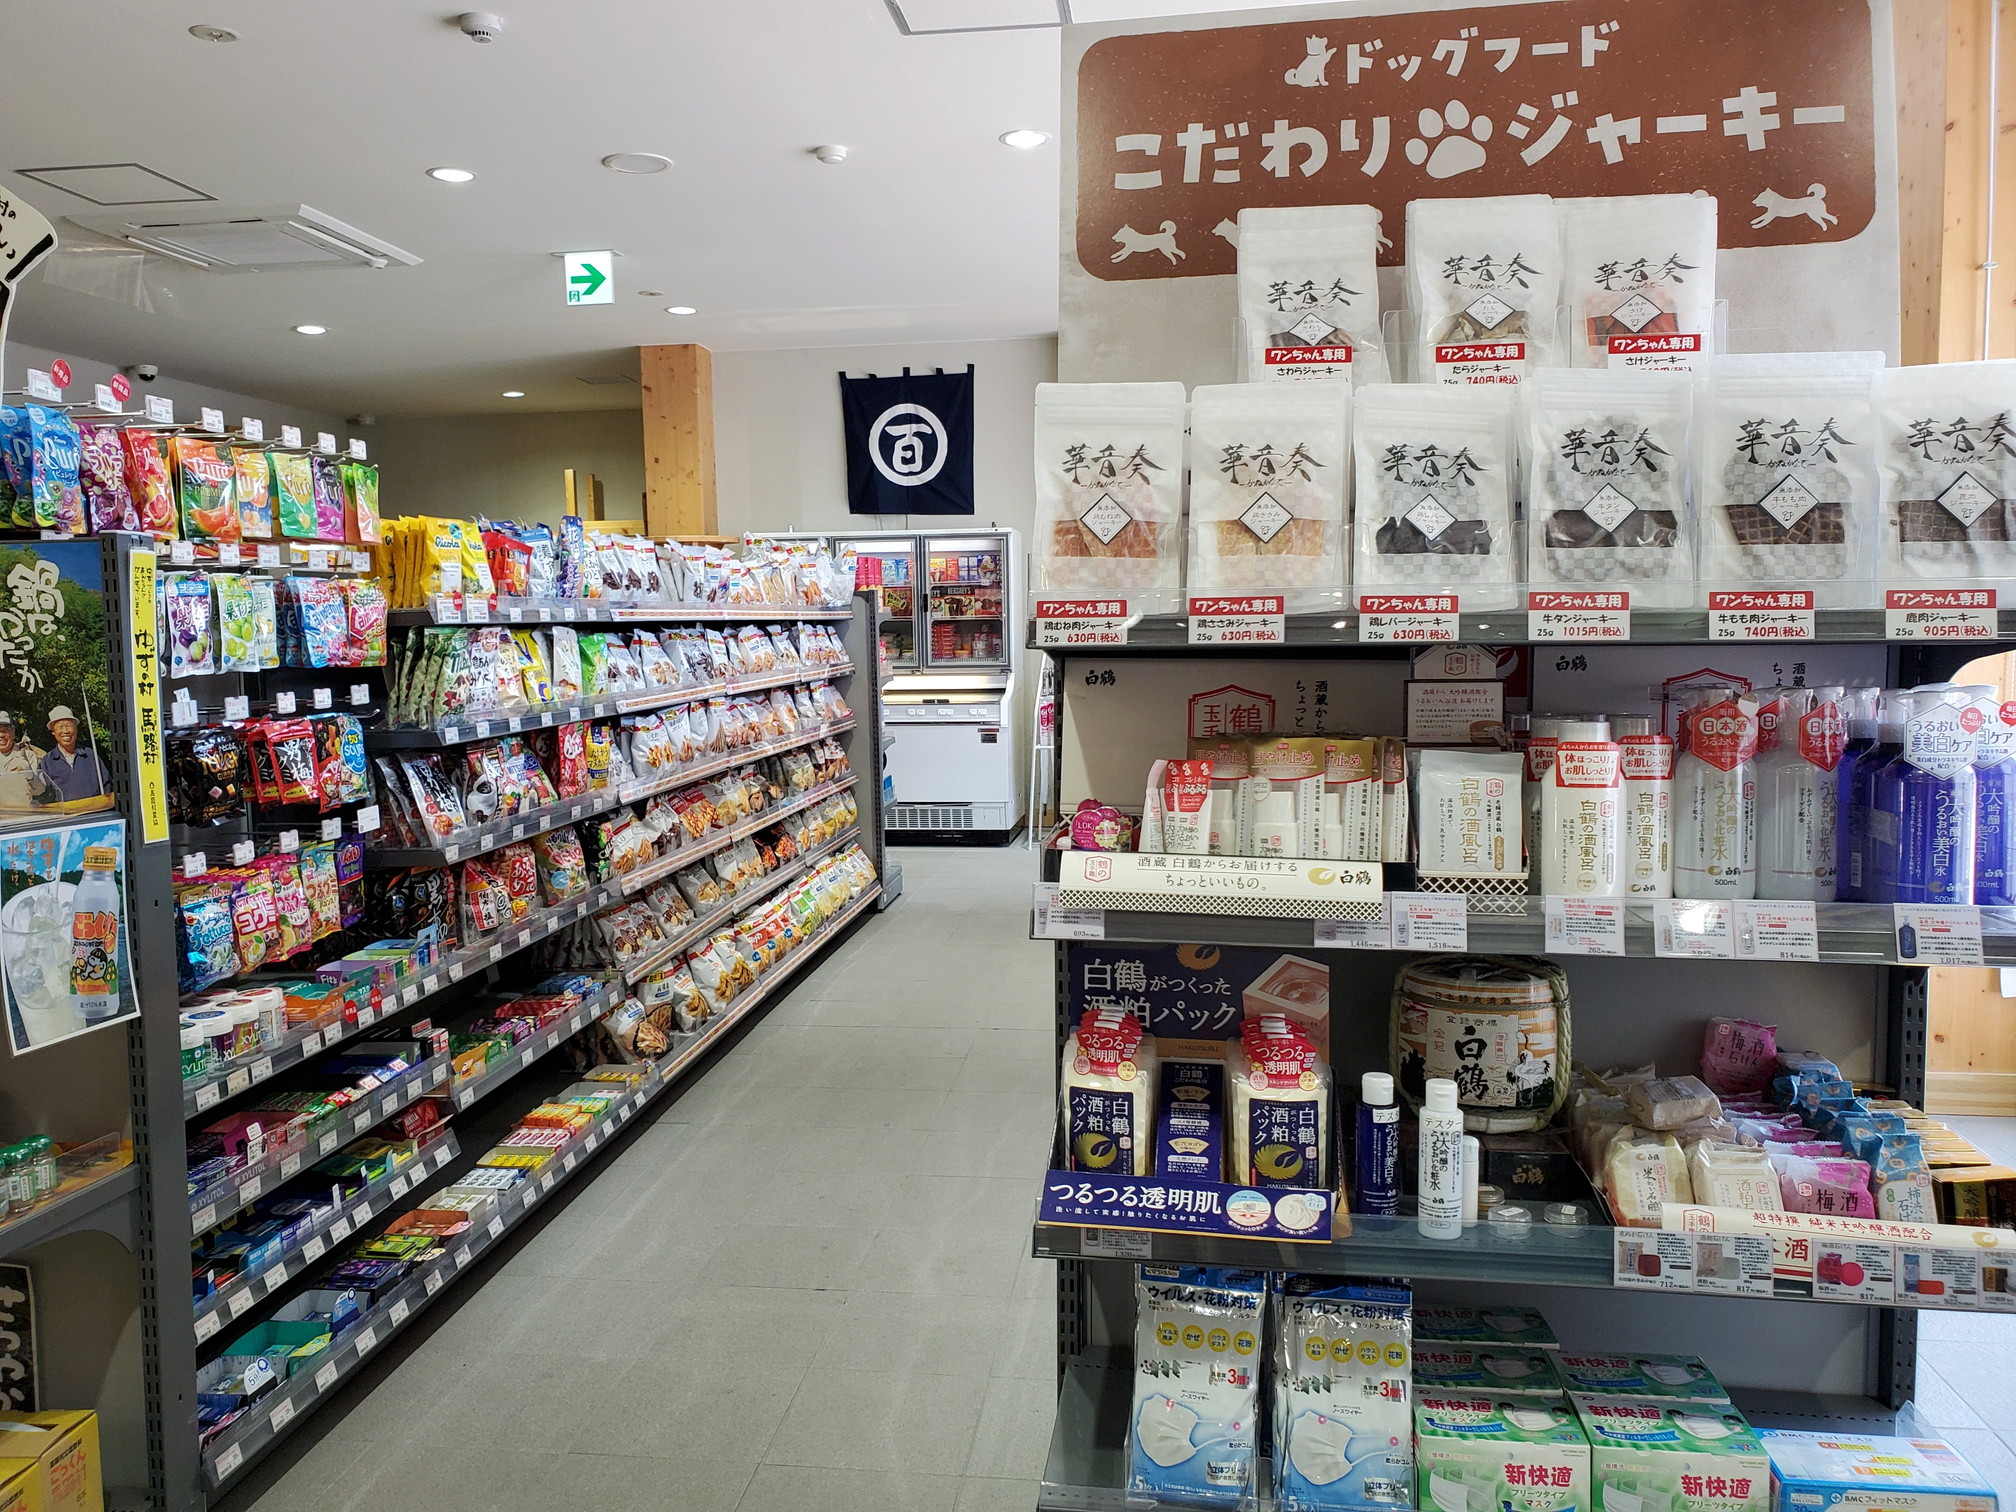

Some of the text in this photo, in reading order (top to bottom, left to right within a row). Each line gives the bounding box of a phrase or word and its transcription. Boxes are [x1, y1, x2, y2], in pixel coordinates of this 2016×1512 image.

[1345, 20, 1621, 84] ドッグフード
[1113, 86, 1845, 191] こだわり ジャーキー
[1442, 253, 1544, 289] 華音奏
[1594, 253, 1700, 291] 華音奏
[1267, 278, 1364, 312] 華音奏
[1614, 336, 1694, 350] ワンちゃん専用
[1270, 348, 1346, 362] ワンちゃん専用
[1441, 347, 1518, 360] ワンちゃん専用
[1626, 356, 1686, 365] さけジャーキー
[1277, 366, 1342, 376] さわらジャーキー
[1452, 364, 1510, 374] たらジャーキー
[884, 424, 932, 473] 百
[1736, 417, 1857, 463] 華音奏
[1561, 428, 1673, 472] 華音奏
[1062, 443, 1167, 486] 華音奏
[1219, 442, 1326, 485] 華音奏
[1382, 444, 1490, 486] 華音奏
[1195, 600, 1278, 612] ワンちゃん専用
[1366, 597, 1451, 611] ワンちゃん専用
[1535, 594, 1622, 608] ワンちゃん専用
[1716, 593, 1806, 607] ワンちゃん専用
[1894, 592, 1989, 606] ワンちゃん専用
[1042, 602, 1121, 615] ワンちゃん専用
[1906, 612, 1980, 622] 鹿肉ジャーキー
[1044, 621, 1121, 631] 鶏むね肉ジャーキー
[1197, 619, 1278, 629] 鶏ささみジャーキー
[1369, 616, 1452, 627] 鶏レバージャーキー
[1543, 613, 1618, 623] 牛タンジャーキー
[1718, 613, 1808, 624] 牛もも肉ジャーキー
[1067, 633, 1124, 643] 630円(税込)
[1197, 631, 1280, 641] 25g 630円(税込)
[1368, 628, 1454, 640] 25g 630円(税込)
[1537, 625, 1625, 637] 25g 1015円(税込)
[1718, 626, 1809, 638] 25g 740円(税込)
[1896, 626, 1993, 637] 25g 905円(税込)
[134, 629, 155, 696] ゆずの村
[1556, 655, 1588, 672] 白鶴
[1085, 669, 1116, 686] 白鶴
[1792, 662, 1806, 687] 酒蔵
[1294, 680, 1307, 728] ちょっと
[1314, 680, 1328, 732] 酒蔵から
[1702, 719, 1749, 733] 日本酒
[1912, 720, 1960, 733] うるおい
[140, 708, 157, 765] 馬路村
[1911, 732, 1972, 753] 美白ケア
[1254, 750, 1315, 765] 日やけ止め
[1565, 753, 1610, 764] 体ほっこり!
[1625, 746, 1667, 757] 体ほっこり!
[1565, 765, 1614, 775] お肌しっとり!
[1625, 757, 1670, 768] お肌しっとり!
[1986, 788, 2004, 834] 大吟醸の
[1459, 777, 1482, 864] 白鶴の酒風呂
[1636, 792, 1655, 860] 白鶴の酒風呂
[1711, 781, 1728, 862] うるおい化粧水
[1948, 801, 1964, 846] 大吟醸の
[1578, 800, 1598, 871] 白鶴の酒風呂
[1932, 789, 1950, 877] うるおい美白水
[1137, 856, 1299, 873] 酒蔵 白鶴からお届けする
[1985, 868, 2004, 878] 白鶴
[1165, 875, 1267, 892] ちょっといいもの。
[1340, 869, 1372, 886] 白鶴
[237, 899, 278, 936] コグミ
[320, 974, 338, 985] Fit's
[1083, 957, 1233, 996] 白鶴がつくった
[1080, 1032, 1125, 1048] つるつる
[1730, 1030, 1765, 1056] 梅酒
[1086, 1048, 1121, 1062] 透明肌
[1255, 1046, 1306, 1060] つるつる
[1728, 1051, 1758, 1068] 石けん
[1263, 1060, 1301, 1075] 透明肌
[1453, 1025, 1490, 1101] 白鶴
[1072, 1095, 1087, 1132] パック
[1087, 1096, 1104, 1132] 酒粕
[1111, 1098, 1130, 1135] 白鶴
[1253, 1107, 1269, 1145] パック
[1271, 1107, 1290, 1142] 酒粕
[1298, 1108, 1316, 1145] 白鶴
[1424, 1117, 1462, 1129] テスター
[1428, 1130, 1441, 1191] うるおい化粧水
[1439, 1137, 1451, 1172] 大吟醸の
[241, 1162, 266, 1183] XYLITOL
[1512, 1167, 1543, 1185] 白鶴
[198, 1186, 225, 1209] XYLITOL
[1049, 1181, 1222, 1215] つるつる透明肌
[1816, 1188, 1859, 1212] 梅酒
[1907, 1186, 1924, 1215] 柿渋
[1752, 1210, 1934, 1242] 超特撰 純米大吟醸酒配合
[1147, 1285, 1260, 1311] ウイルス・花粉対策
[1292, 1300, 1406, 1321] ウイルス・花粉対策
[1185, 1333, 1200, 1342] かぜ
[1237, 1339, 1252, 1348] 花粉
[1334, 1347, 1349, 1355] かぜ
[1387, 1350, 1403, 1360] 花粉
[1412, 1352, 1473, 1364] 新快適
[1561, 1357, 1631, 1369] 新快適
[1422, 1398, 1493, 1413] 新快適
[1587, 1405, 1663, 1420] 新快適
[1504, 1463, 1573, 1488] 新快適
[1511, 1489, 1567, 1499] プリーツタイプ
[1680, 1474, 1752, 1499] 新快適
[1526, 1500, 1552, 1508] マスク
[1688, 1500, 1745, 1510] プリーツタイプ
[1844, 1495, 1918, 1506] BMCフィットマスク
